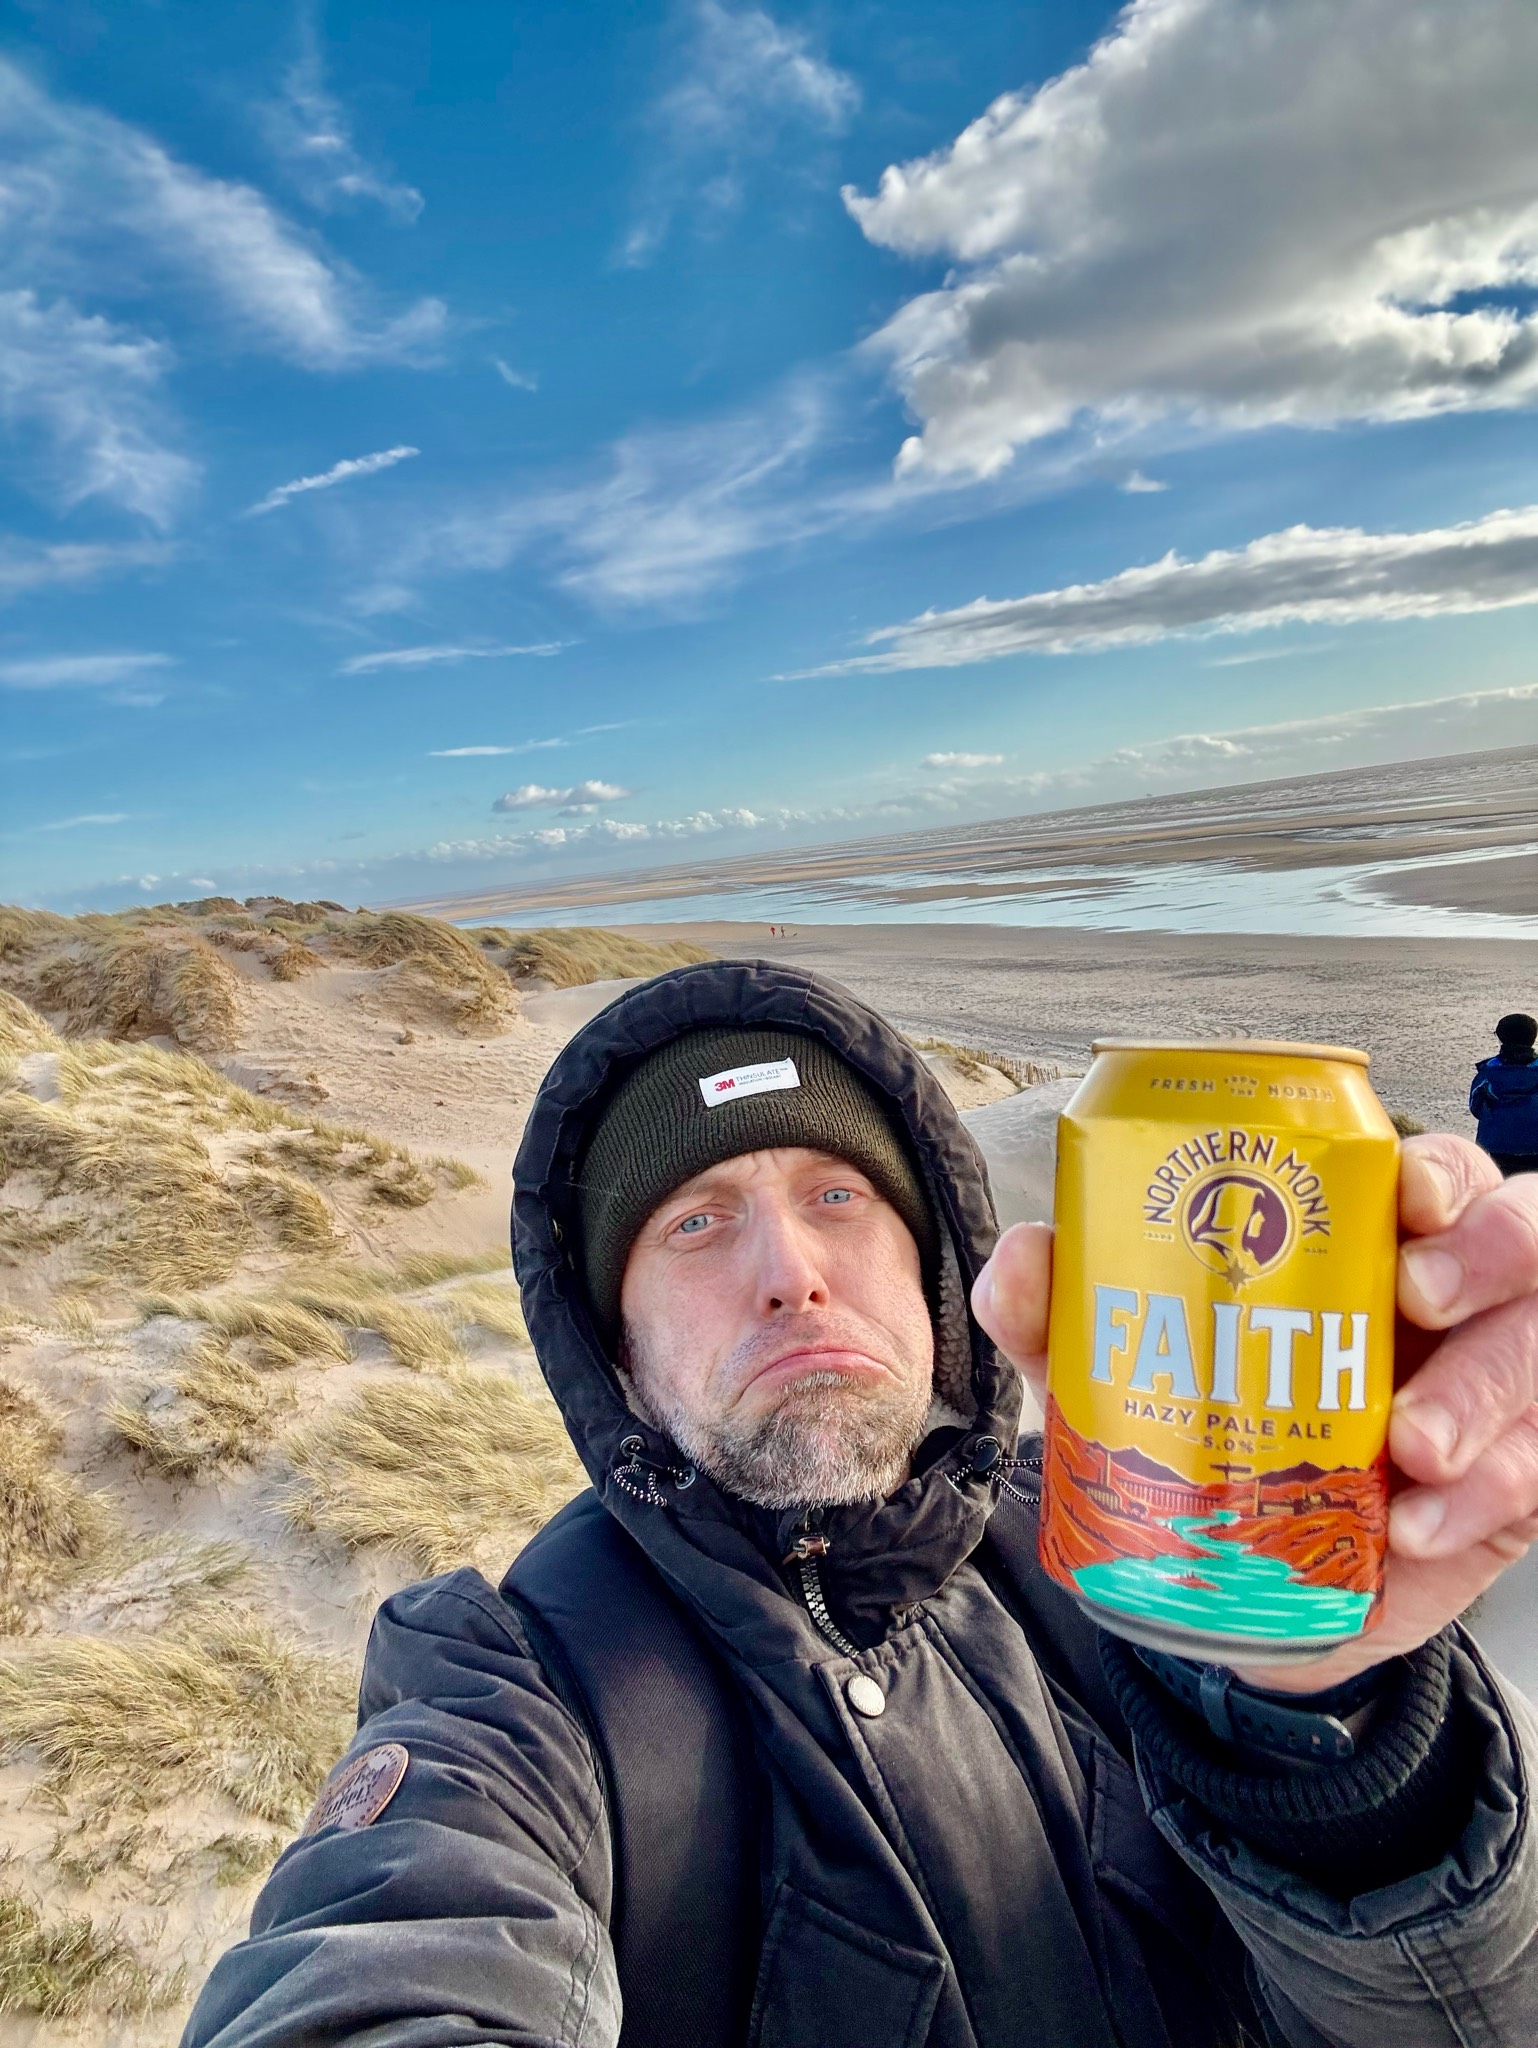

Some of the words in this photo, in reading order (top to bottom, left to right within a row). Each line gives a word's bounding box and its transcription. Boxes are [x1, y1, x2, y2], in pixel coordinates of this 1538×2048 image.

[714, 1079, 735, 1092] 3M
[736, 1068, 780, 1082] THINSULATE
[1150, 1077, 1214, 1092] FRESH
[1268, 1084, 1334, 1101] NORTH
[1143, 1130, 1275, 1224] NORTHERN
[1275, 1148, 1331, 1237] MONK
[1089, 1284, 1370, 1412] FAITH
[1124, 1399, 1194, 1425] HAZY
[1206, 1413, 1275, 1438] PALE
[1287, 1423, 1332, 1440] ALE
[1203, 1435, 1255, 1454] 5.0%
